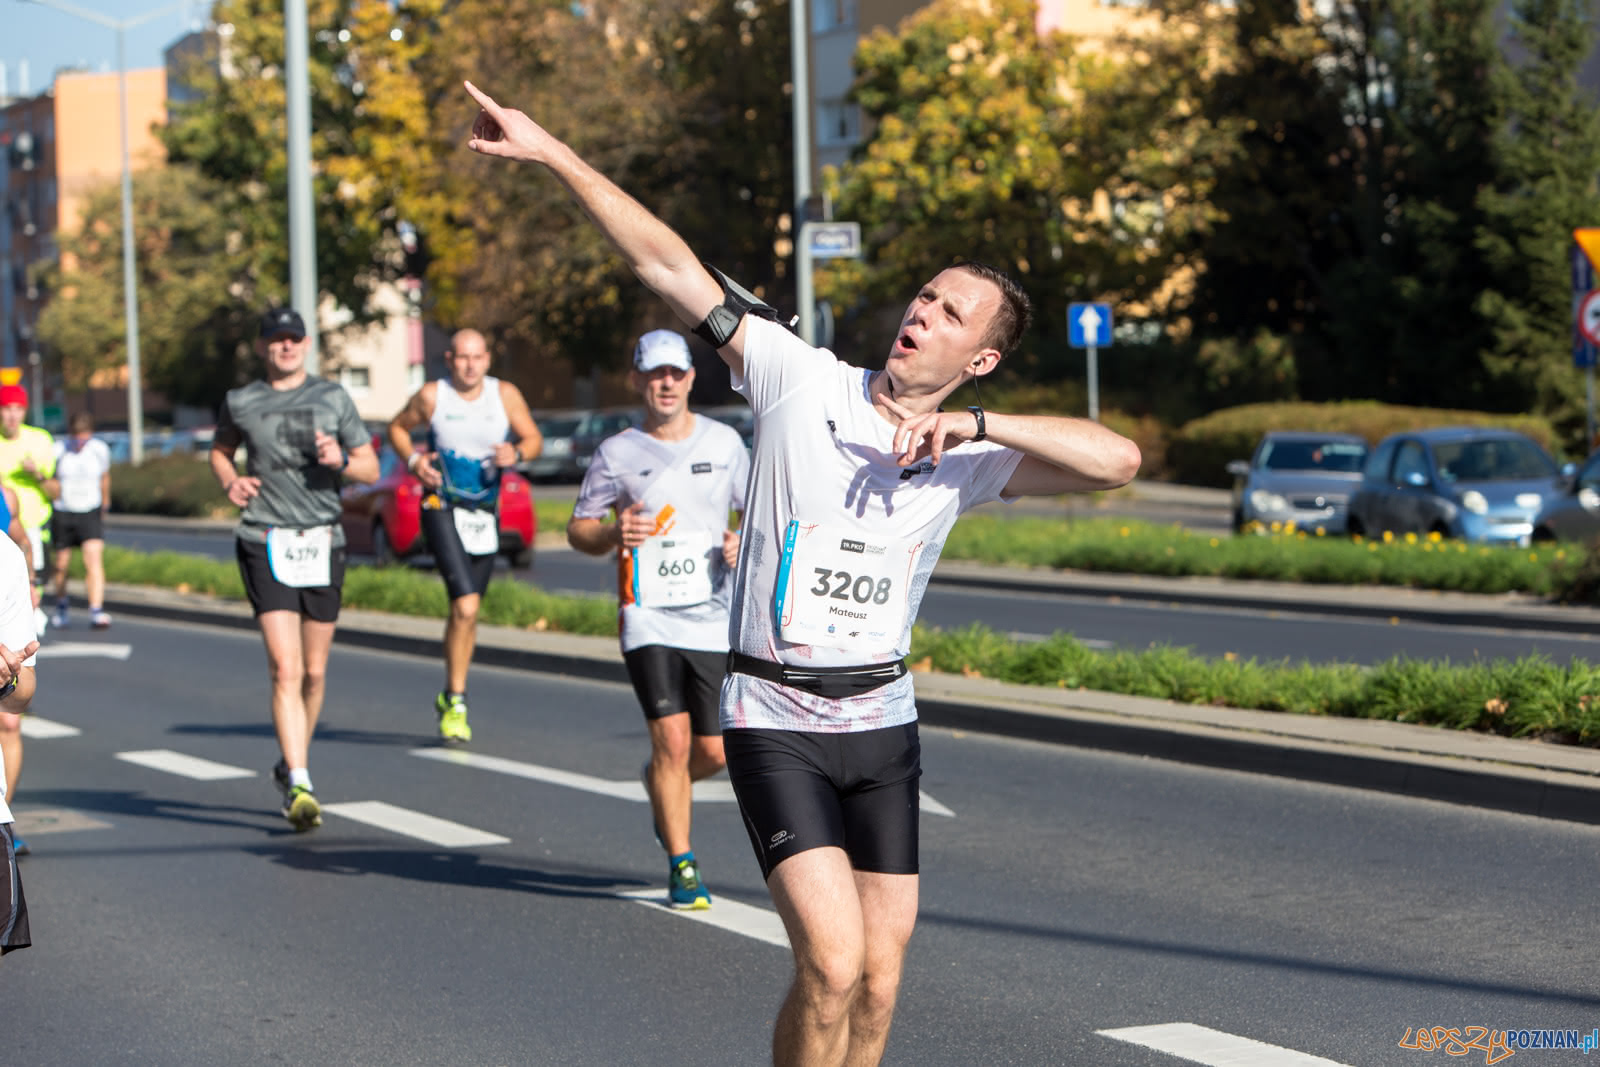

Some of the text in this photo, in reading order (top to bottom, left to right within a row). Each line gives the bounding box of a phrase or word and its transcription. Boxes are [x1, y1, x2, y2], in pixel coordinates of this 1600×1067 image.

[658, 558, 695, 576] 660
[810, 567, 892, 605] 3208
[829, 606, 868, 620] Mateusz
